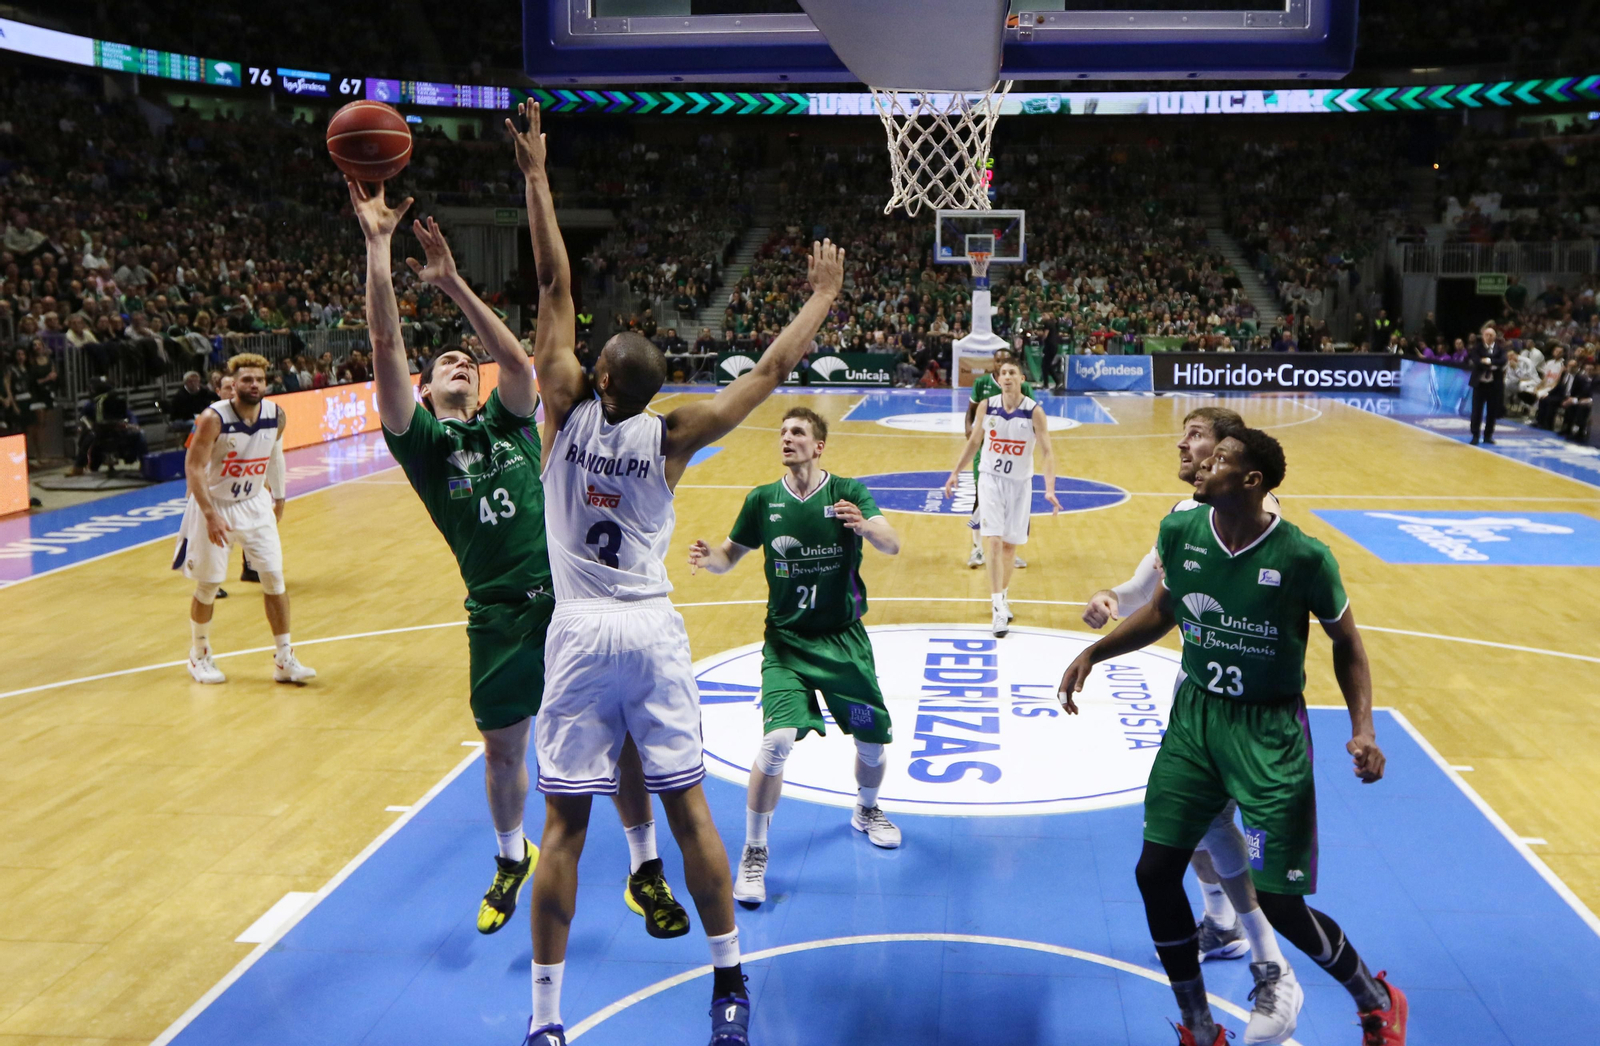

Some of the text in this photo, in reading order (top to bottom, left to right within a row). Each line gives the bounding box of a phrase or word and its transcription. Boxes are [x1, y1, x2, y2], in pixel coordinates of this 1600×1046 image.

[249, 67, 272, 87] 76
[340, 78, 362, 95] 67
[845, 368, 890, 383] Unicaja
[565, 443, 651, 479] RANDOLPH
[994, 459, 1013, 474] 20
[231, 480, 253, 498] 44
[479, 487, 516, 526] 43
[585, 520, 622, 570] 3
[801, 543, 843, 557] Unicaja
[1183, 559, 1193, 571] 40
[796, 584, 817, 609] 21
[1220, 614, 1279, 637] Unicaja
[1207, 661, 1244, 696] 23
[907, 638, 1002, 784] PEDRIZAS
[1010, 684, 1059, 718] LAS
[1102, 663, 1167, 750] AUTOPISTA
